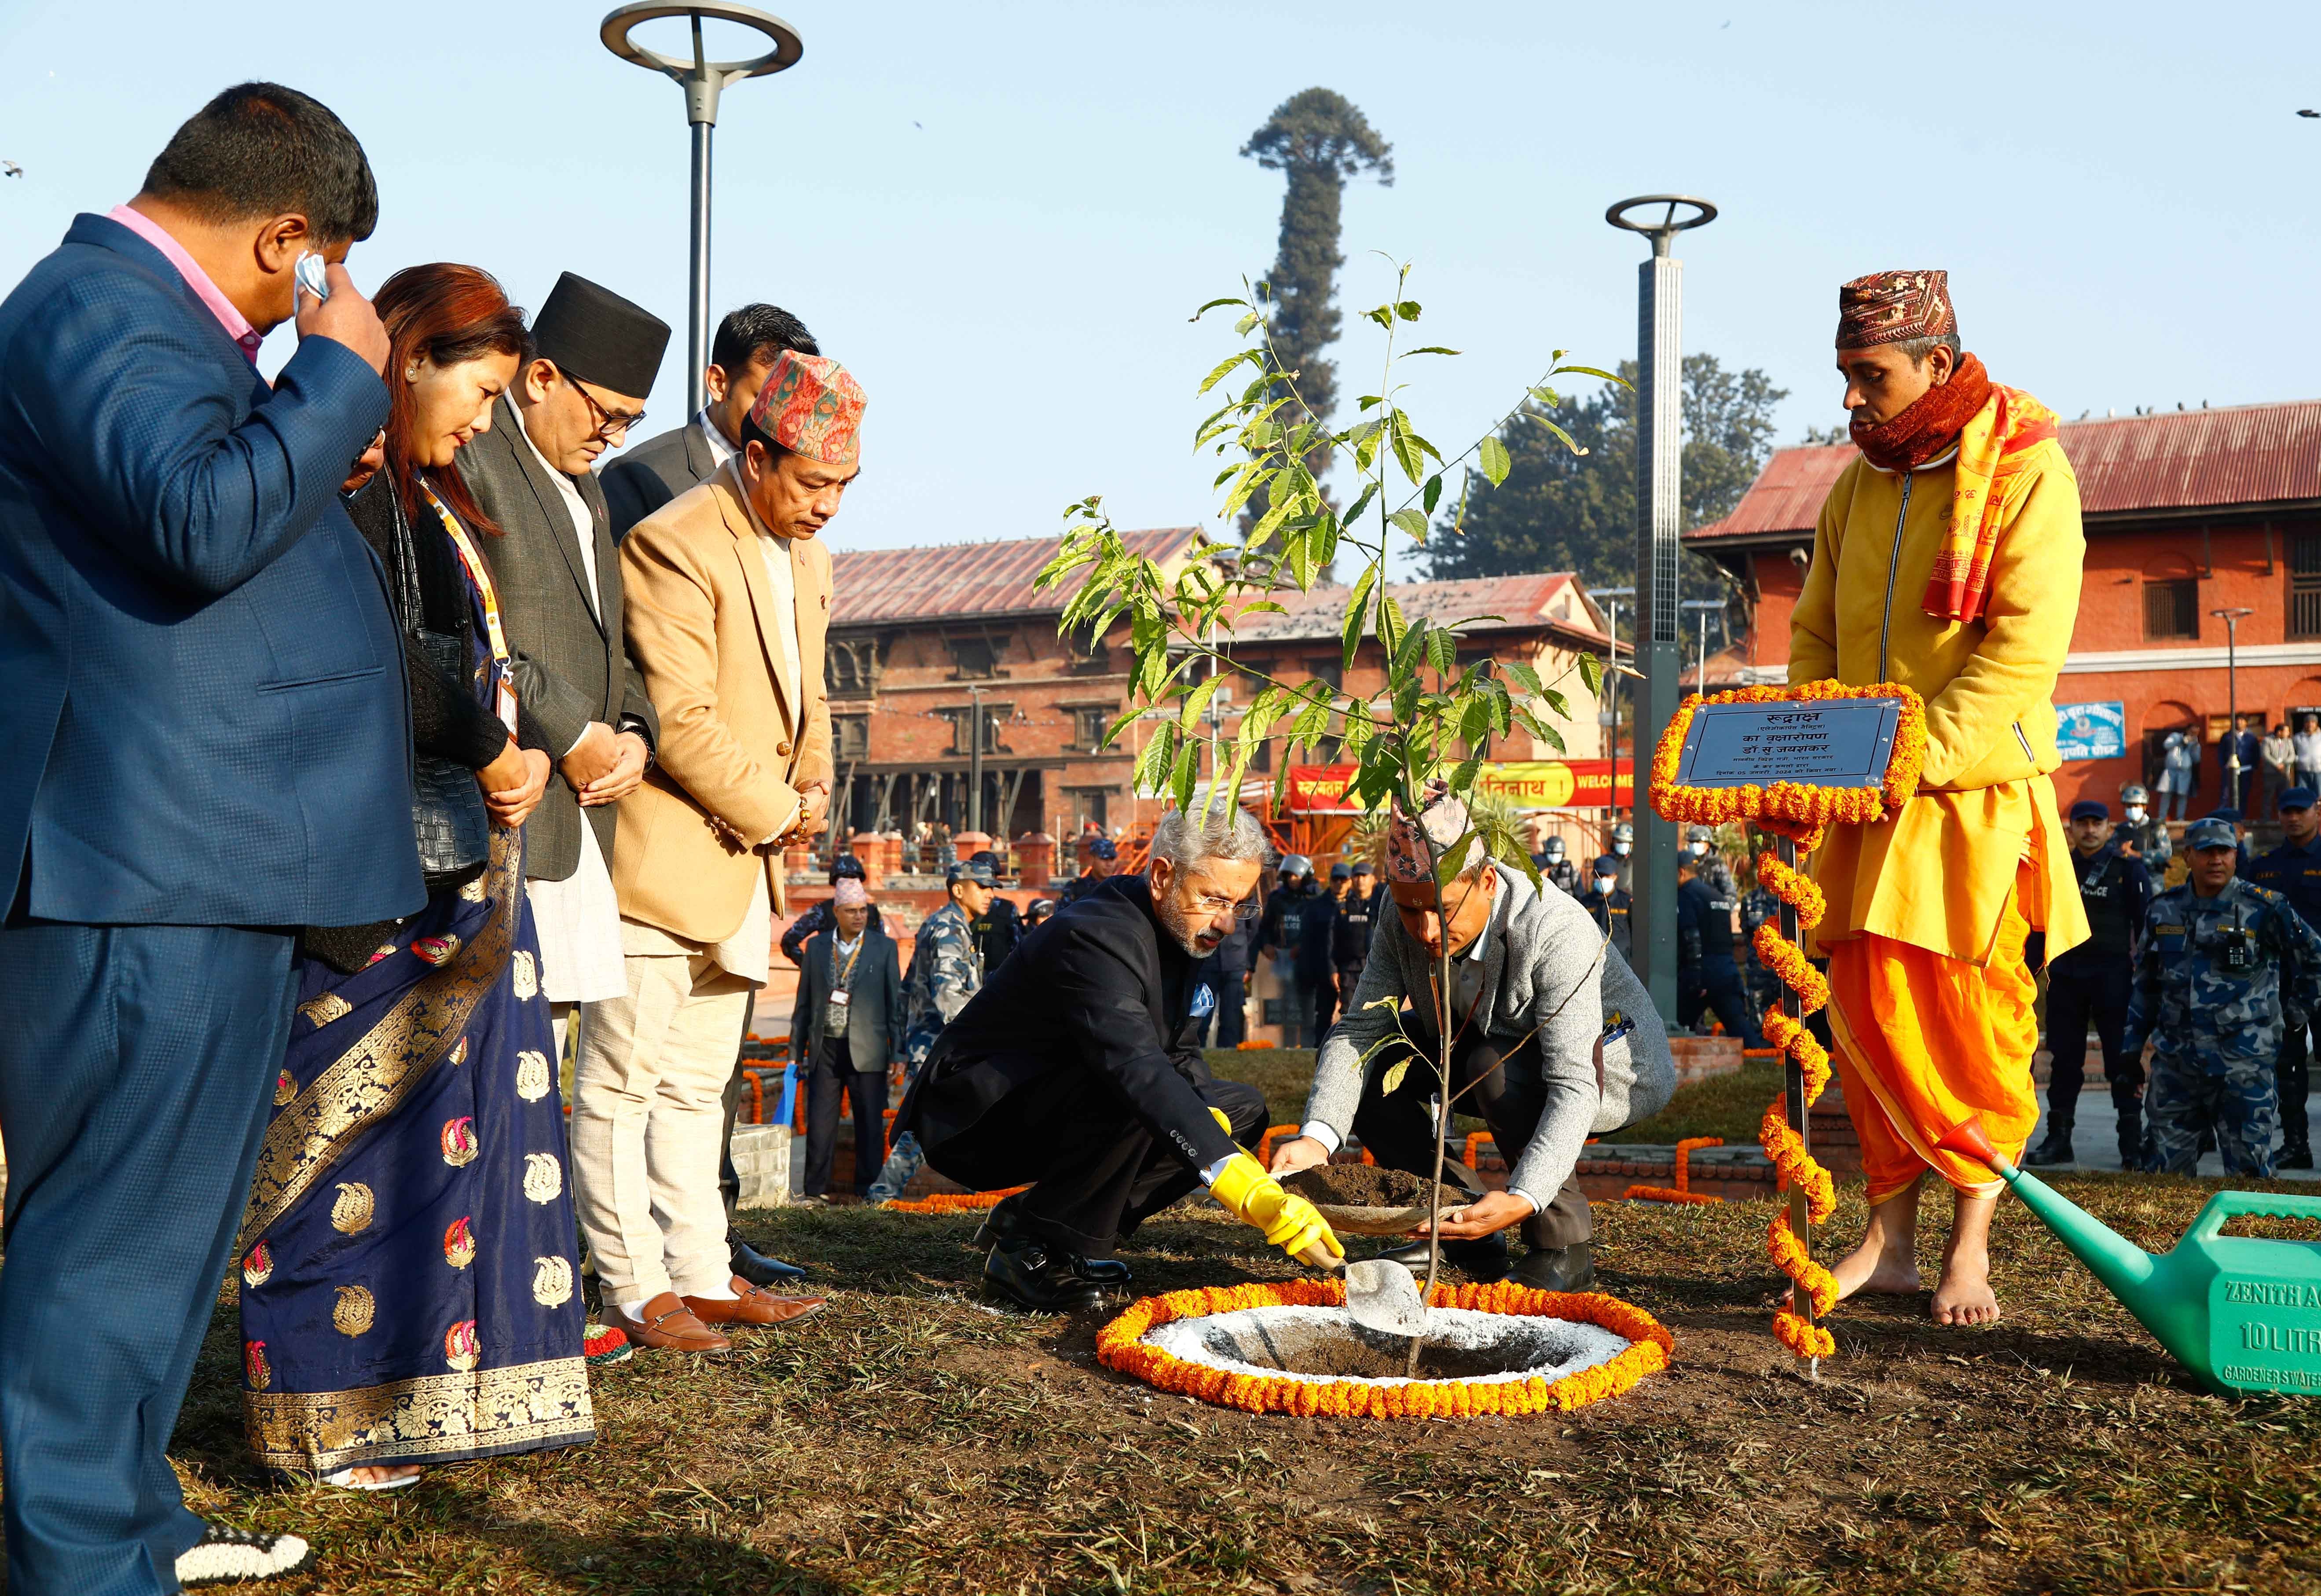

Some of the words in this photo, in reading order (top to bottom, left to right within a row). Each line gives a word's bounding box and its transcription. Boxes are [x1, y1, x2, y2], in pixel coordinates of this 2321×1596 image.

[1766, 733, 1829, 744] वृक्षारोपण
[2225, 1280, 2302, 1307] ZENITH
[2304, 1284, 2321, 1308] A
[2239, 1321, 2267, 1350] 10
